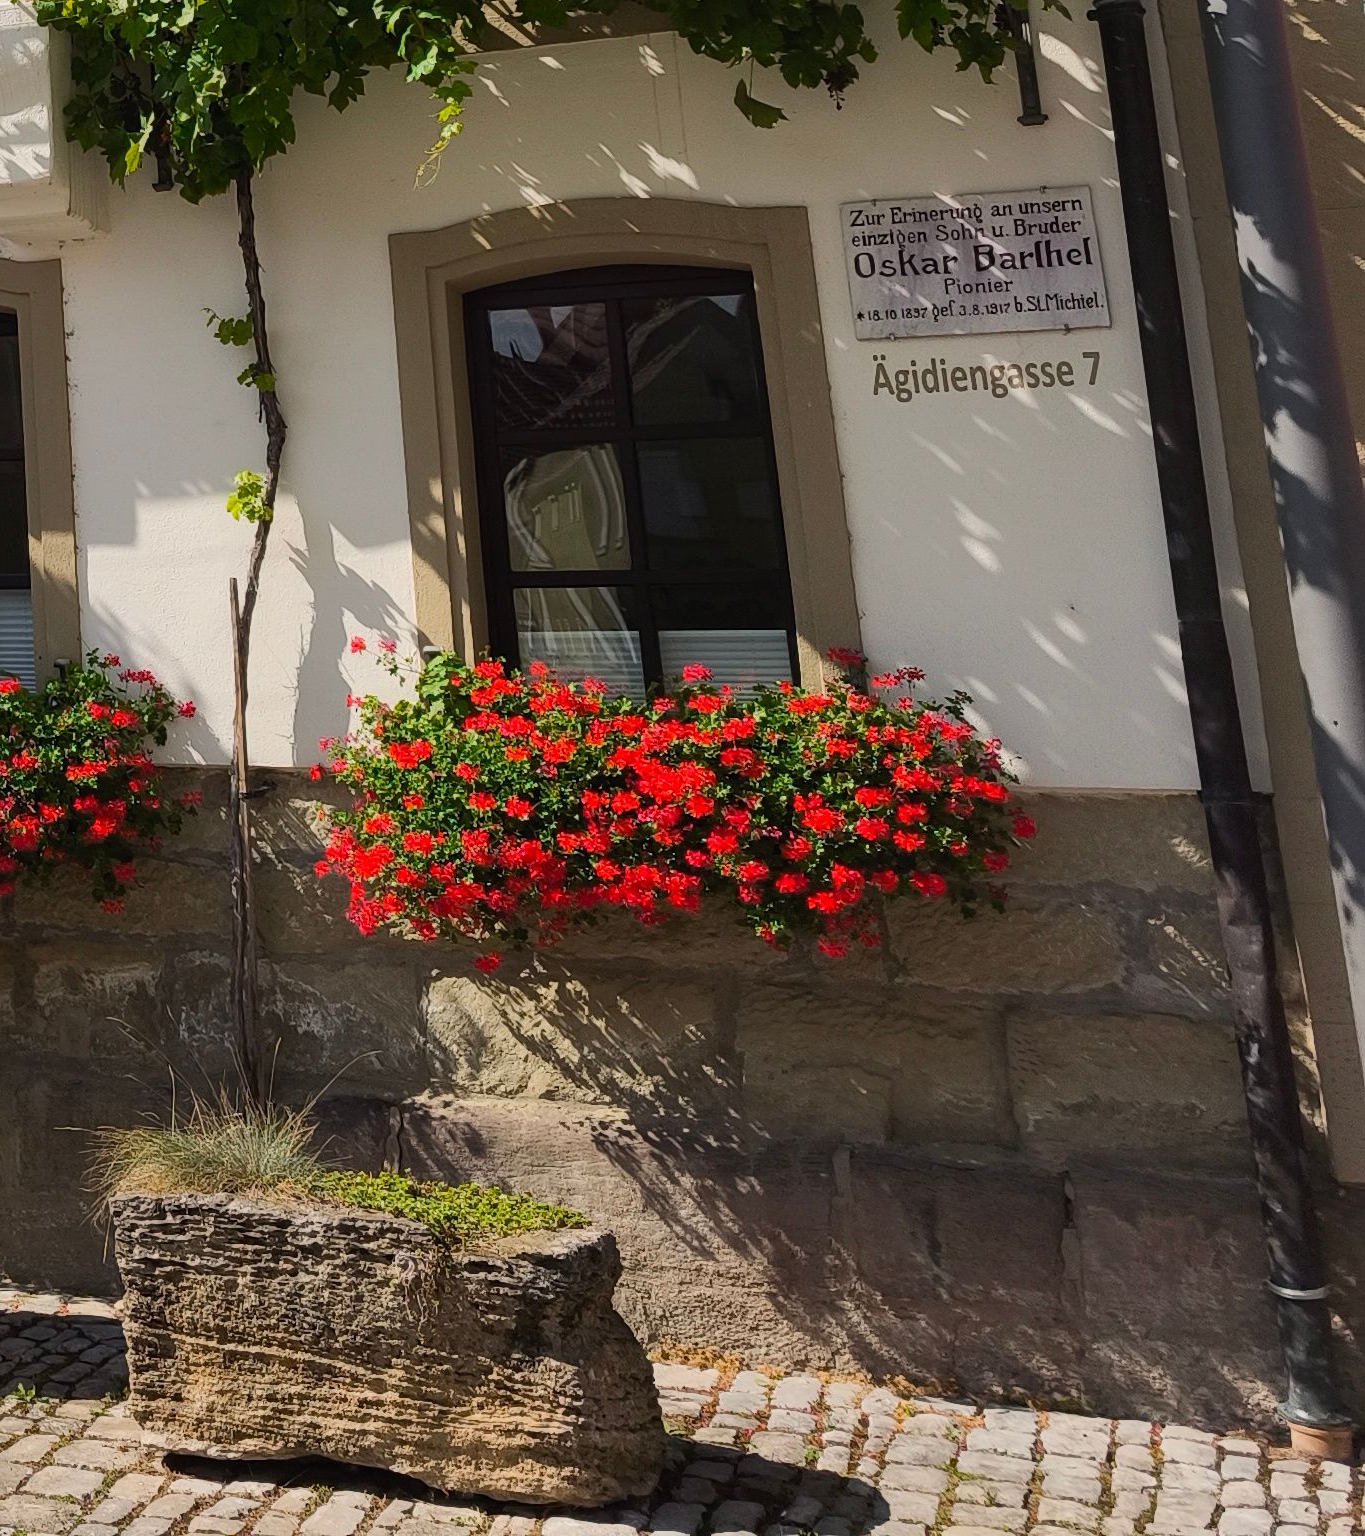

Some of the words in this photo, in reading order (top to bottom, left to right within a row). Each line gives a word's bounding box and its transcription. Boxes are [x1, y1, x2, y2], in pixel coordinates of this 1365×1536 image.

[850, 210, 885, 227] Zur
[991, 204, 1013, 217] an
[1019, 198, 1083, 214] unsern
[852, 229, 928, 250] einzigen
[936, 223, 985, 241] Sohn
[992, 225, 1009, 237] u.
[1014, 216, 1081, 236] Bruder
[853, 249, 959, 279] Oskar
[973, 237, 1093, 272] Barthel
[944, 278, 1013, 295] Pionier
[872, 354, 1075, 403] Ägidiengasse
[1082, 352, 1100, 386] 7
